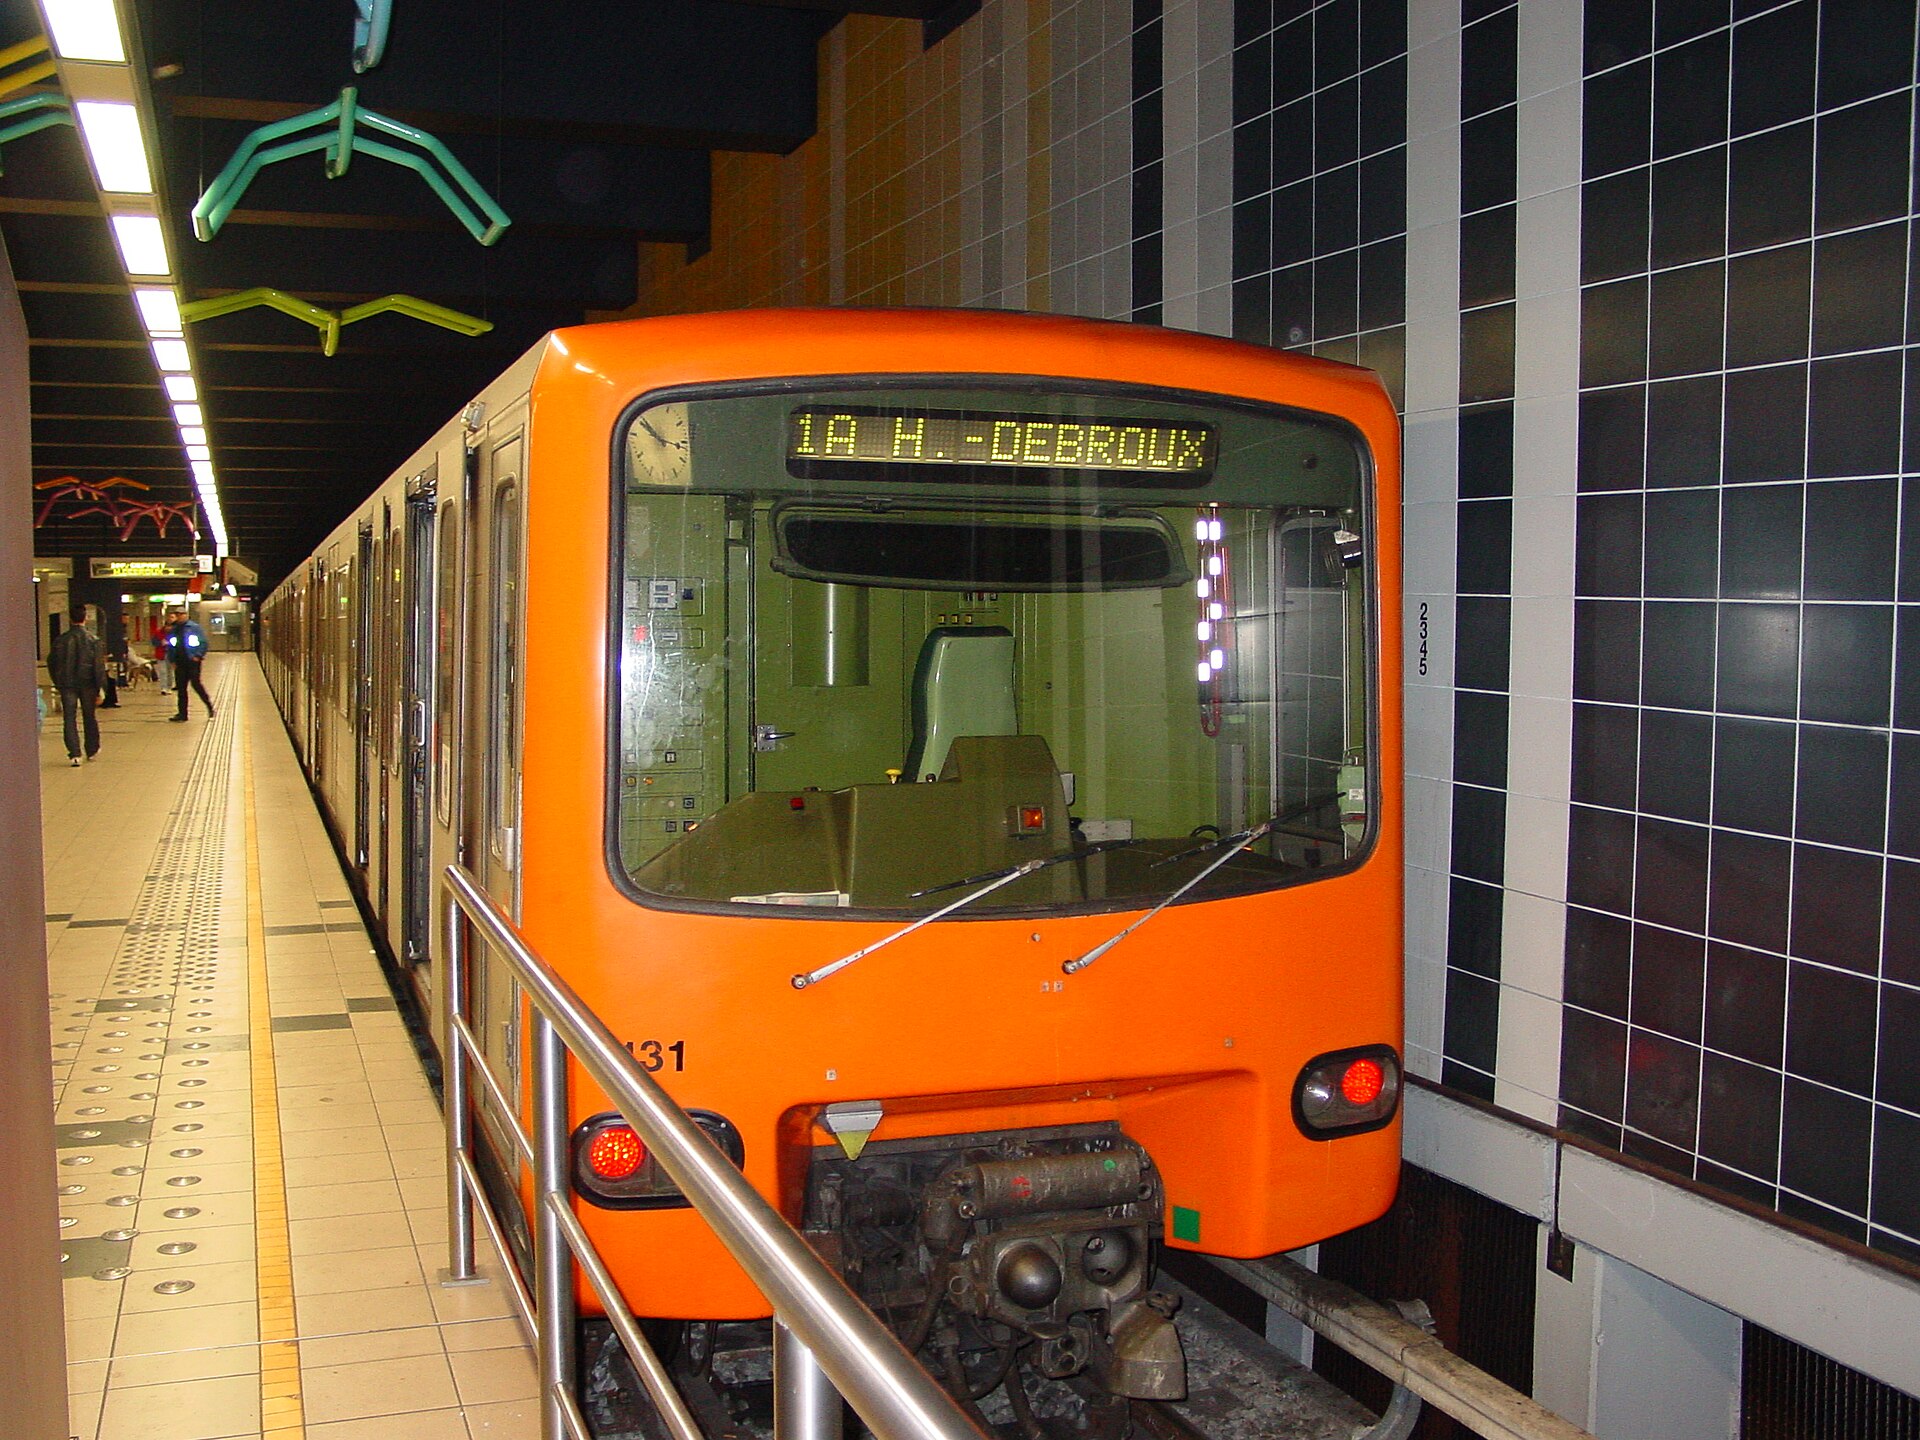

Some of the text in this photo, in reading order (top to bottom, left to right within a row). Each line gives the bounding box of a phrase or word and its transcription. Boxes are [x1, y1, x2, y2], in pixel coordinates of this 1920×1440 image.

[797, 413, 857, 455] 1A
[892, 416, 944, 458] H.
[1419, 602, 1428, 676] 2345
